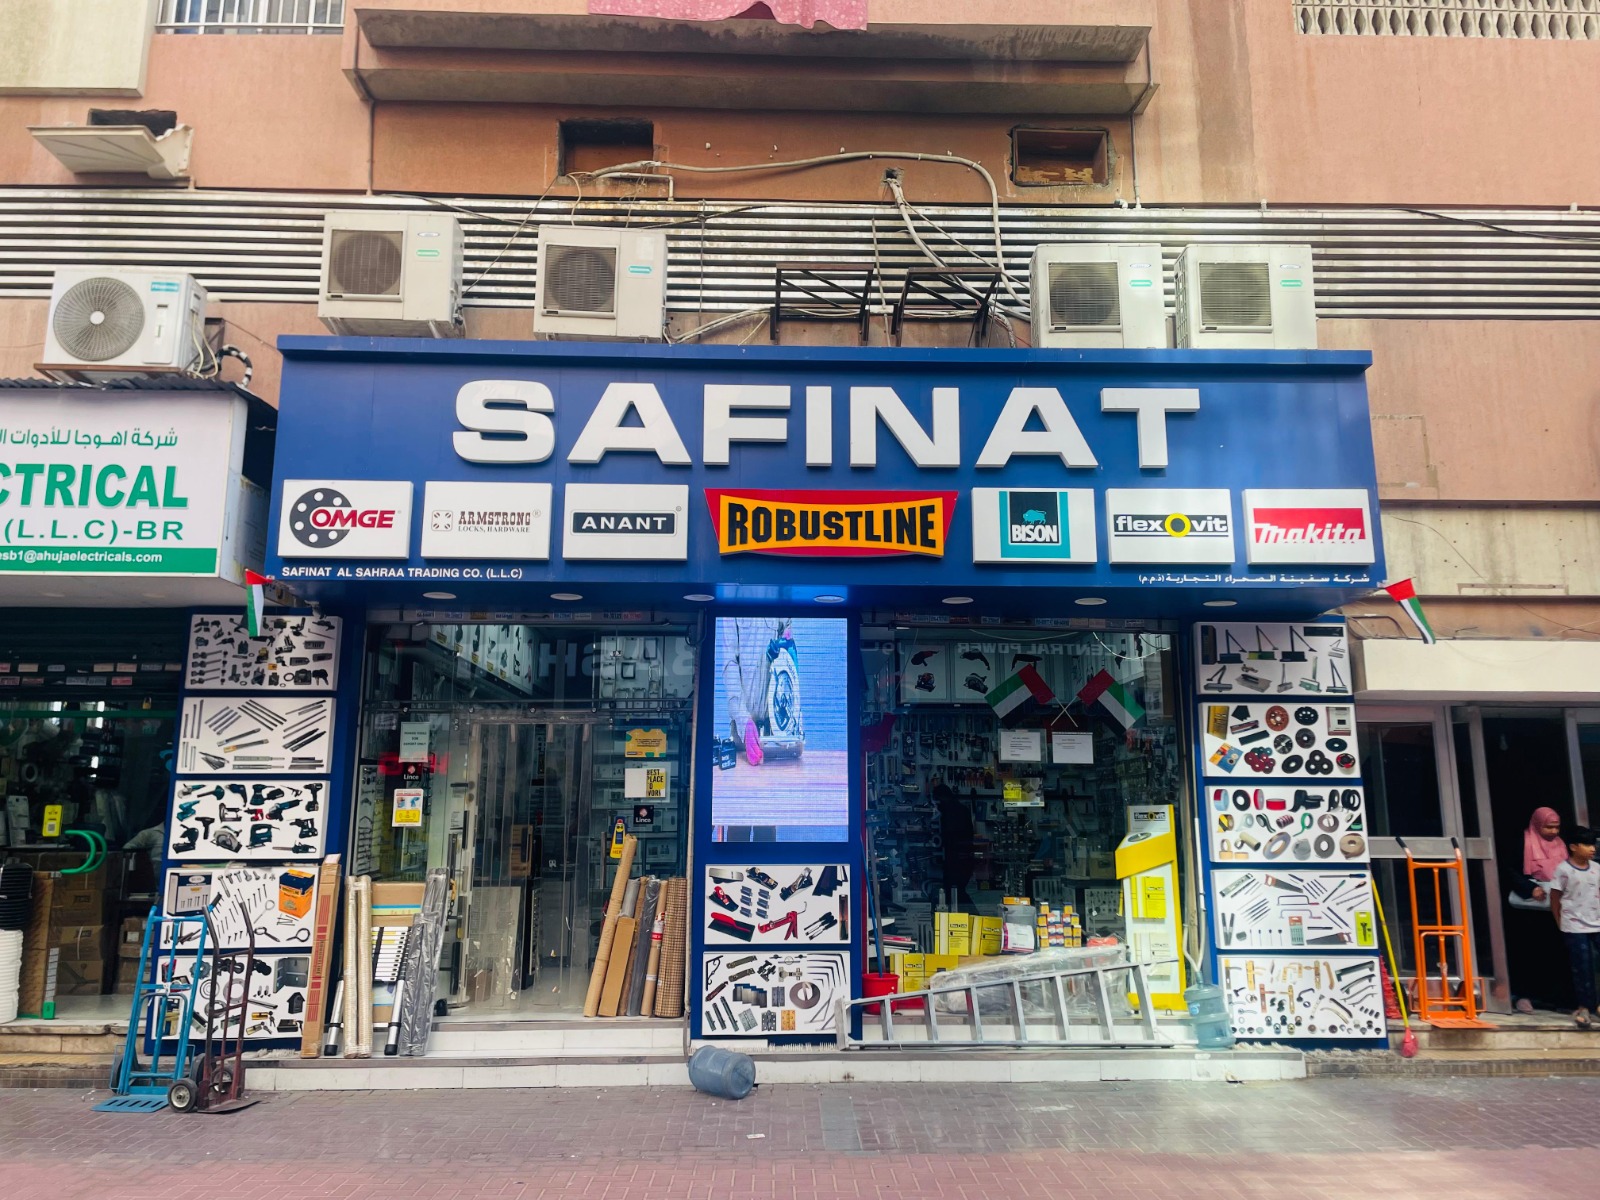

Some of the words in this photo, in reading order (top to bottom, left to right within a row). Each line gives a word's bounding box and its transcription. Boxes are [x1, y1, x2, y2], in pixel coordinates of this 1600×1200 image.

[452, 380, 1200, 468] SAFINAT
[131, 427, 179, 450] شركة
[309, 508, 395, 528] OMGE
[458, 511, 531, 526] ARMSTRONG
[582, 516, 666, 531] ANANT
[727, 502, 936, 548] ROBUSTLINE
[4, 518, 183, 544] (L.L.C)-BR
[1011, 523, 1059, 543] BISON
[282, 567, 332, 578] SAFINAT
[337, 568, 352, 578] AL
[355, 568, 404, 579] SAHRAA
[408, 568, 457, 579] TRADING
[460, 568, 483, 580] CO.
[486, 568, 523, 580] (L.L.C)
